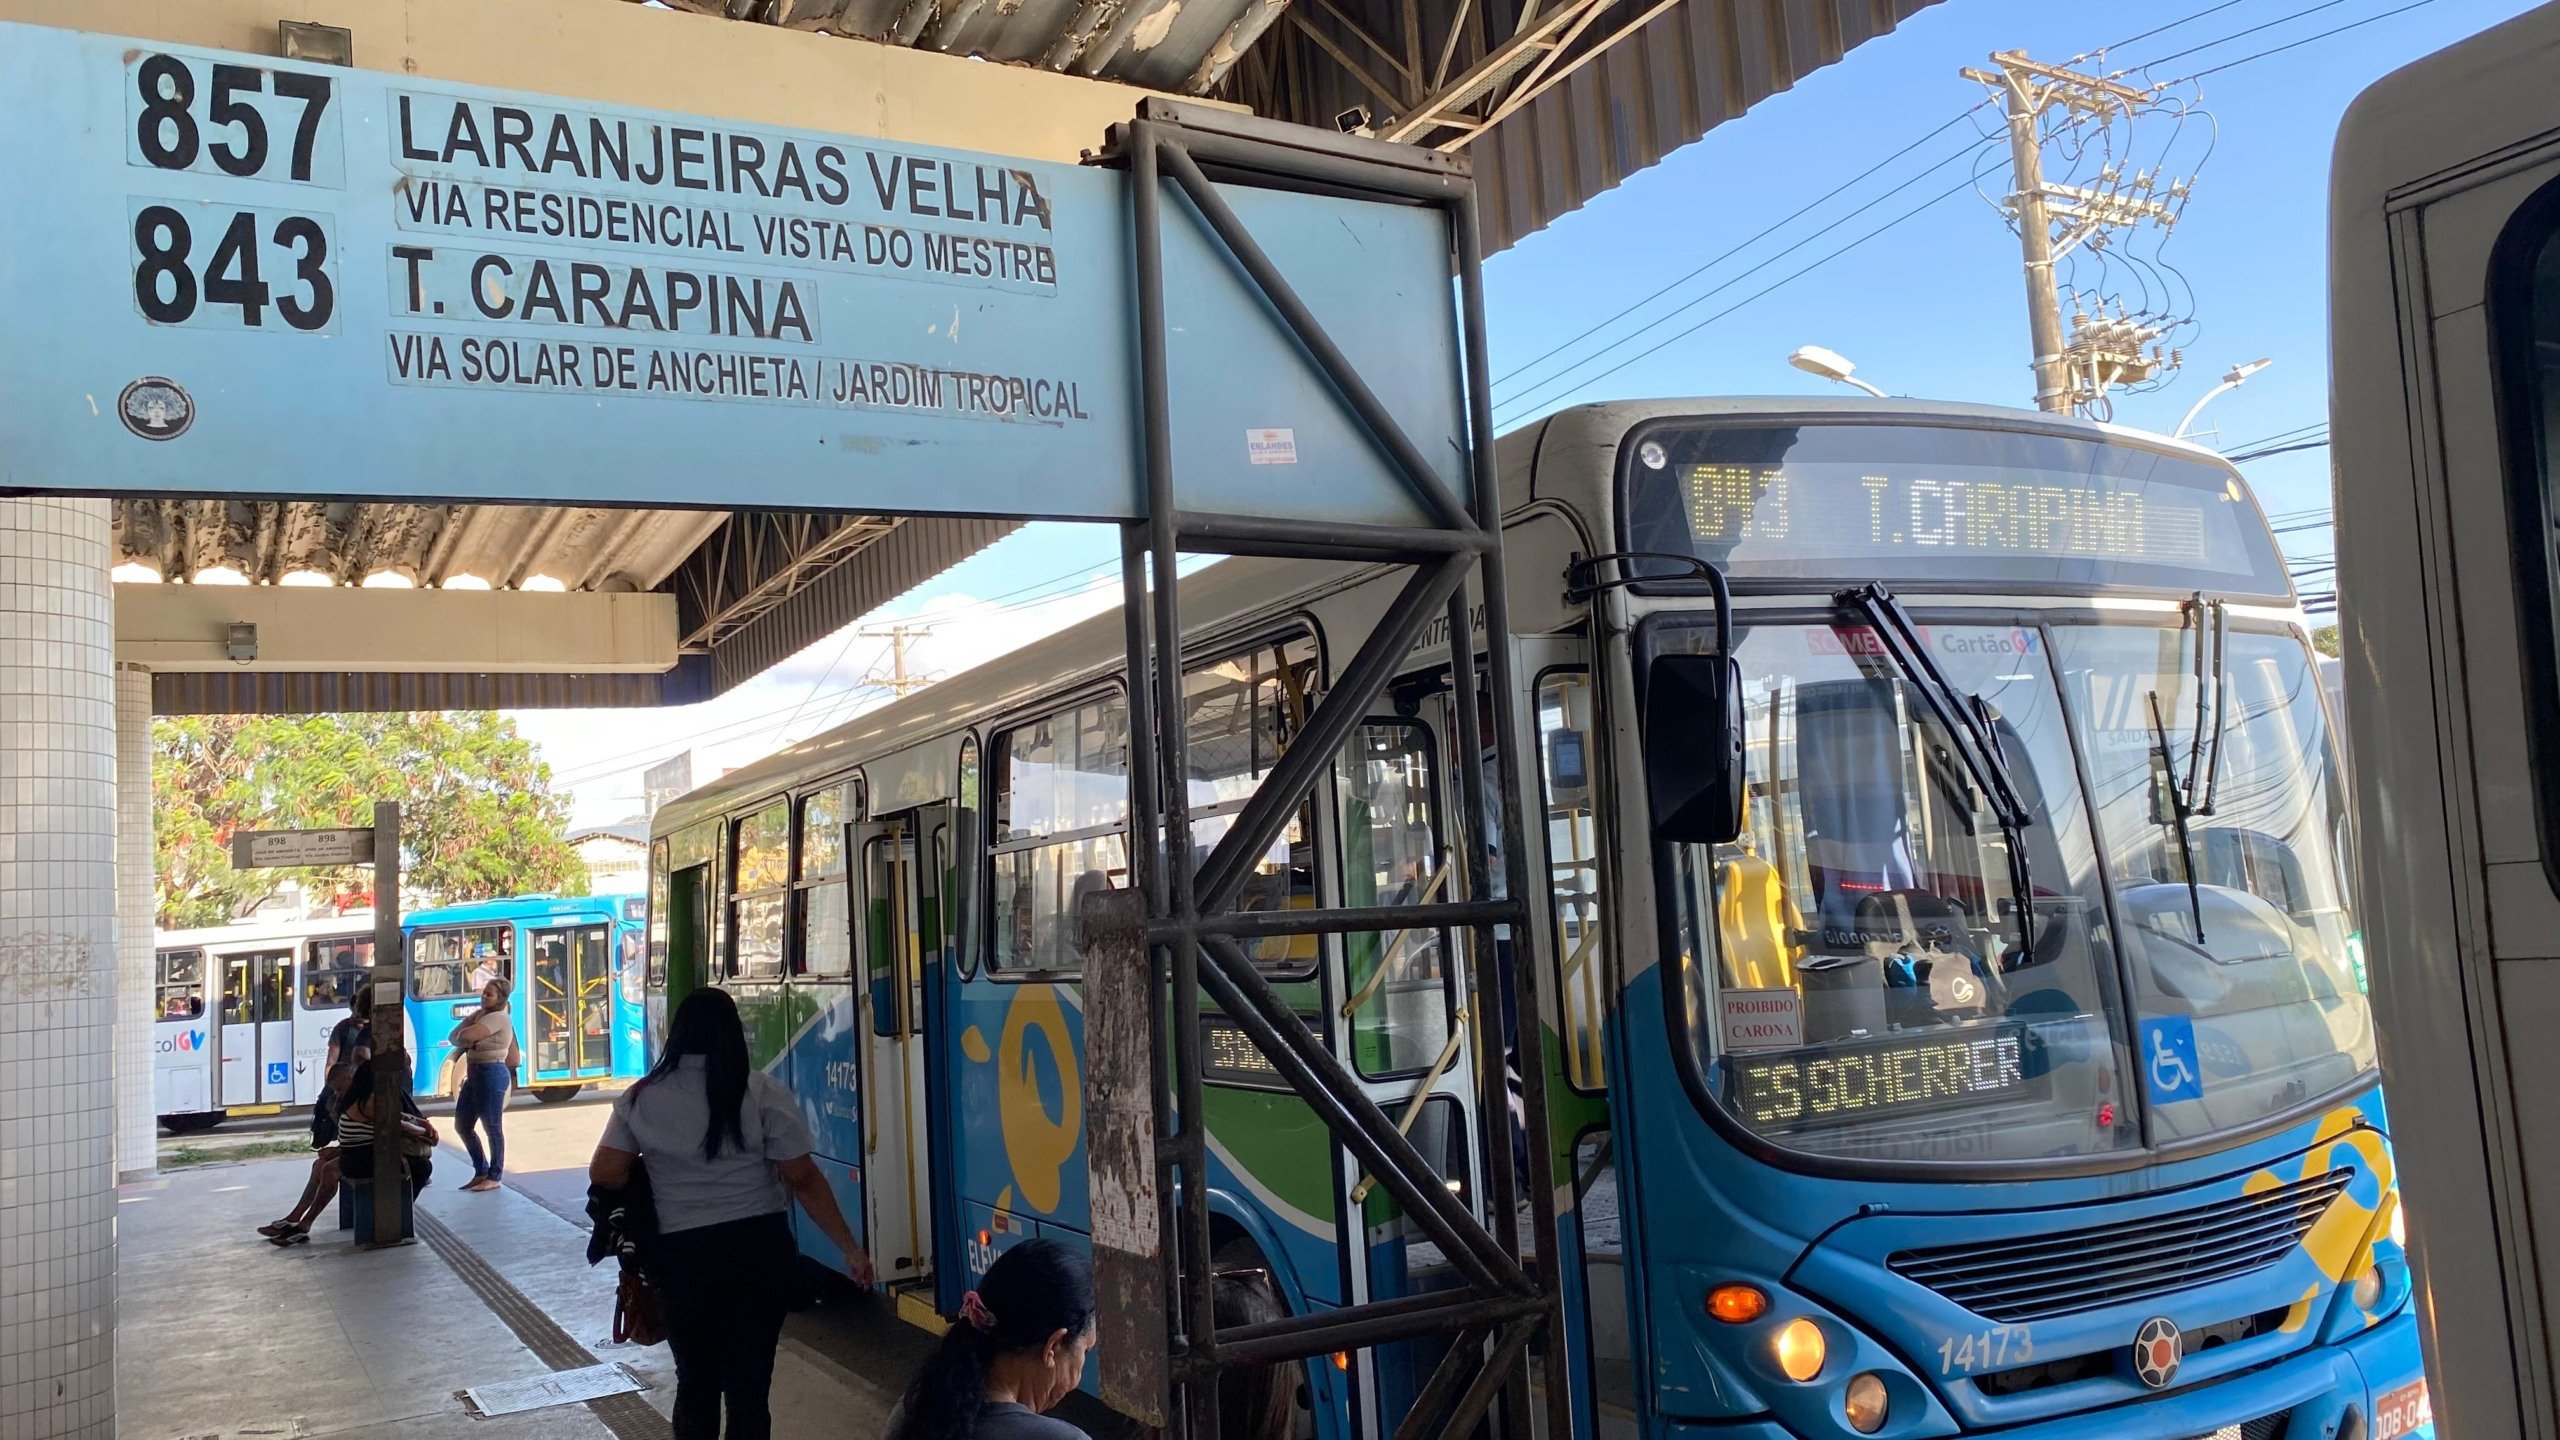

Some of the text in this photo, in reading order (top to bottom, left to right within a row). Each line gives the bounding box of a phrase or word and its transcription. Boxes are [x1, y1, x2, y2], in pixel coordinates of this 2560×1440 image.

[137, 54, 332, 181] 857
[399, 95, 1051, 231] LARANJEIRAS VELHA
[403, 181, 1056, 286] VIA RESIDENCIAL VISTA DO MESTRE
[134, 205, 334, 331] 843
[392, 246, 815, 342] T. CARAPINA
[389, 334, 452, 381] VIA
[462, 338, 582, 387] SOLAR
[593, 346, 637, 390] DE
[648, 350, 809, 401] ANCHIETA
[833, 362, 943, 411] JARDIM
[951, 372, 1089, 421] TROPICAL
[1412, 604, 1486, 651] NTRA
[268, 837, 286, 846] 898
[318, 834, 336, 843] 898
[1727, 999, 1794, 1015] PROIBIDO
[1732, 1023, 1794, 1039] CARONA
[825, 1061, 857, 1092] 14173
[1807, 1036, 2022, 1113] SCHERRER
[1936, 1323, 2035, 1375] 14173
